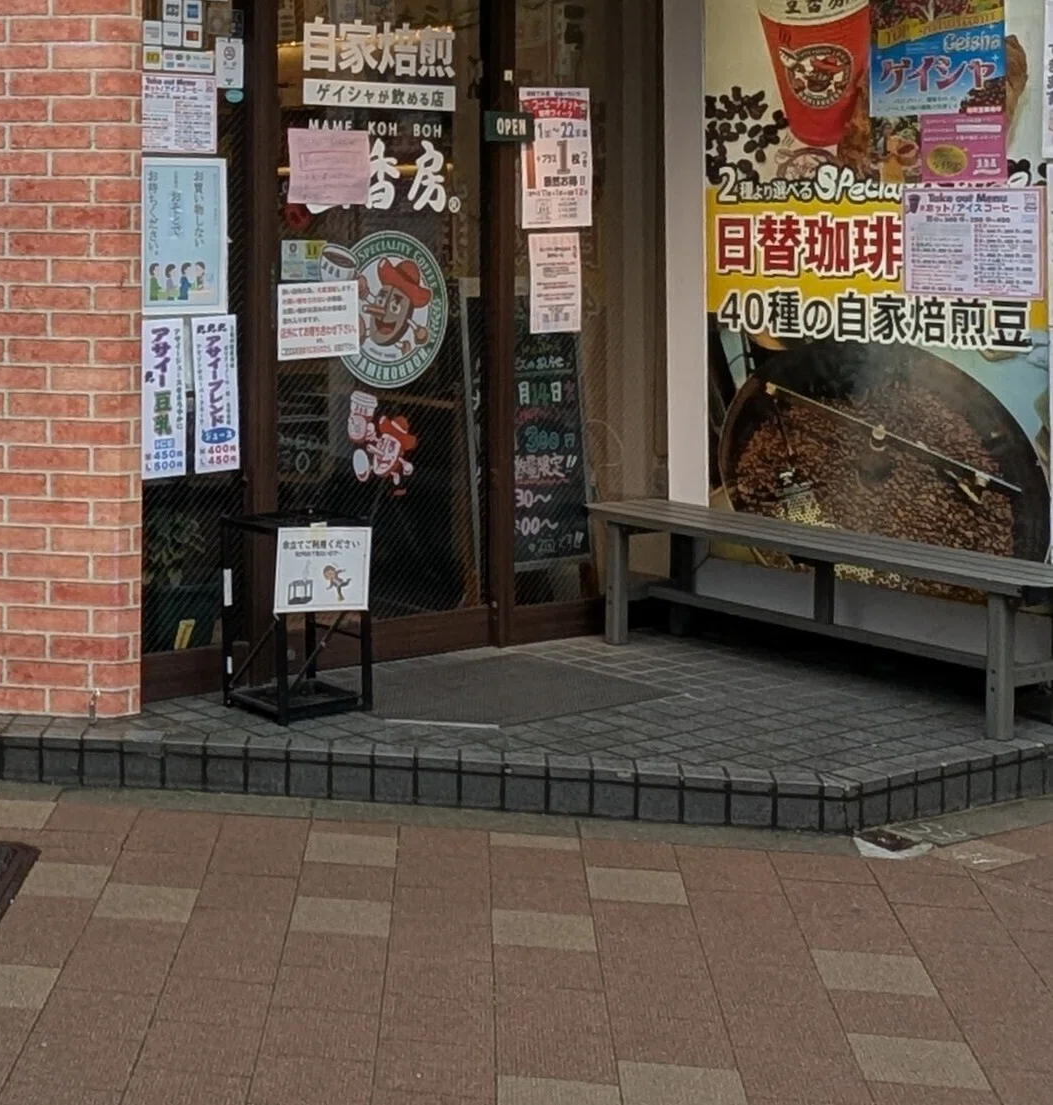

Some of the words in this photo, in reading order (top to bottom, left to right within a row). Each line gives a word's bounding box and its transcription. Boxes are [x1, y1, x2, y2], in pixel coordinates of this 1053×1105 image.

[303, 16, 456, 78] 自家焙煎
[942, 30, 1002, 54] Geisha
[880, 55, 996, 95] ゲイシャ
[316, 83, 445, 108] ゲイシャが飲める店
[368, 121, 398, 137] KOH
[413, 123, 442, 139] BOH
[497, 118, 526, 137] OPEN
[927, 193, 954, 203] Take
[955, 193, 974, 203] out
[976, 193, 1008, 203] Menu
[718, 216, 902, 276] 日替珈琲
[719, 291, 1033, 349] 40種の自家焙煎豆
[154, 449, 183, 461] 450円
[208, 454, 237, 466] 450円
[154, 460, 183, 472] 500円
